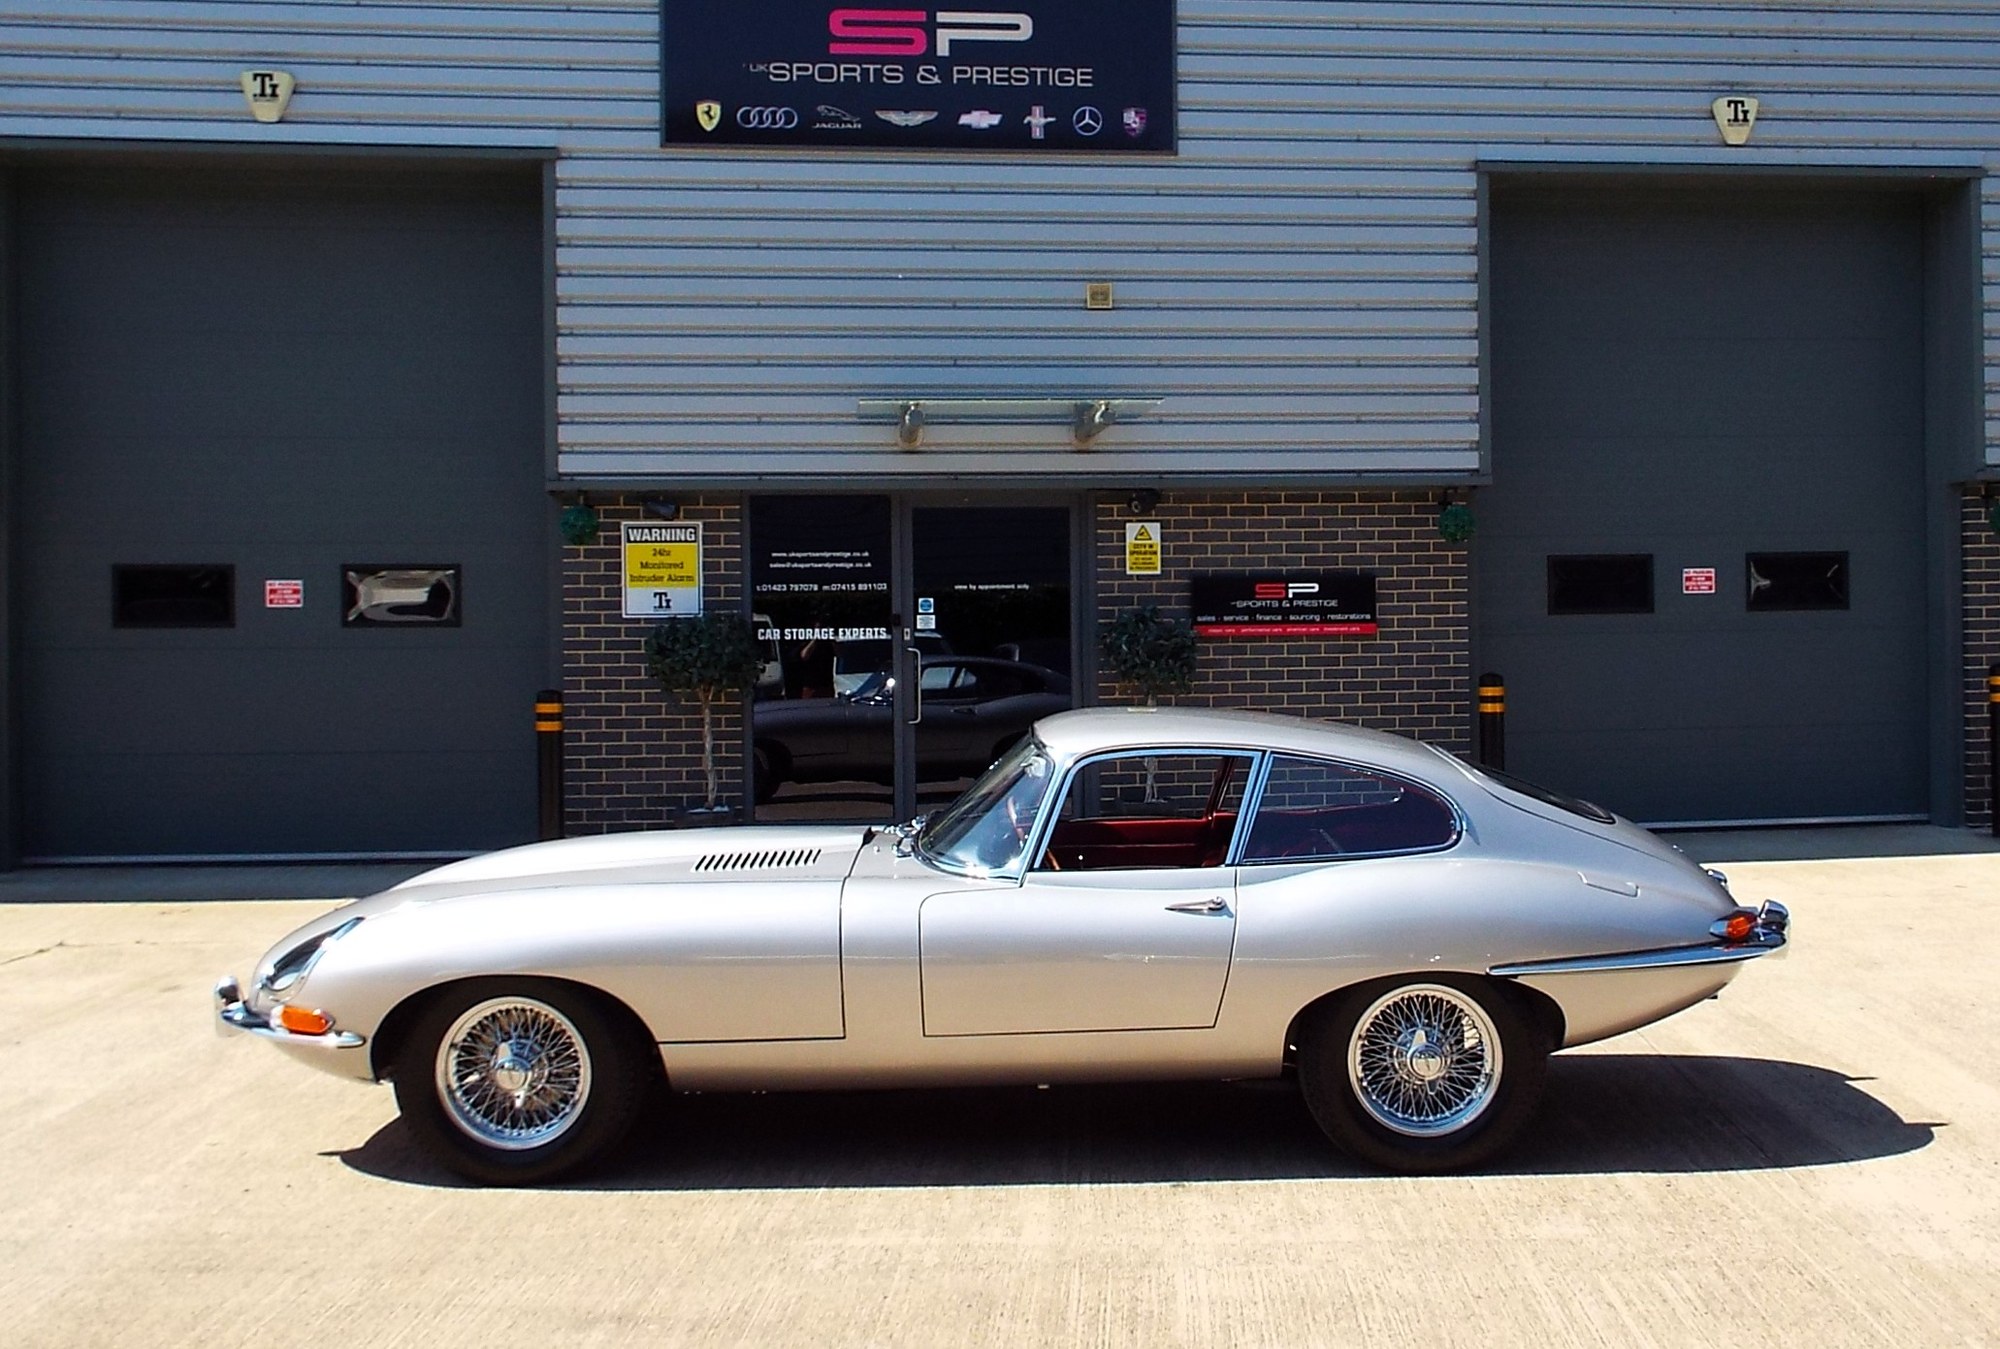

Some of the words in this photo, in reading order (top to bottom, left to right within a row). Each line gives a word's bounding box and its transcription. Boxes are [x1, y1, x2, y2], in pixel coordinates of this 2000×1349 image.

[829, 9, 1034, 57] SP
[768, 62, 905, 84] SPORTS
[916, 65, 942, 84] &
[953, 66, 1094, 87] PRESTIGE
[628, 528, 696, 542] WARNING
[652, 547, 671, 556] 24hr
[640, 561, 684, 569] Monitored
[629, 574, 665, 582] Intruder
[667, 574, 694, 582] Alarm
[1255, 583, 1319, 598] SP
[1197, 614, 1216, 622] sales
[1289, 614, 1320, 622] sourcing
[758, 628, 780, 640] CAR
[784, 628, 835, 640] STORAGE
[838, 627, 887, 640] EXPERTS
